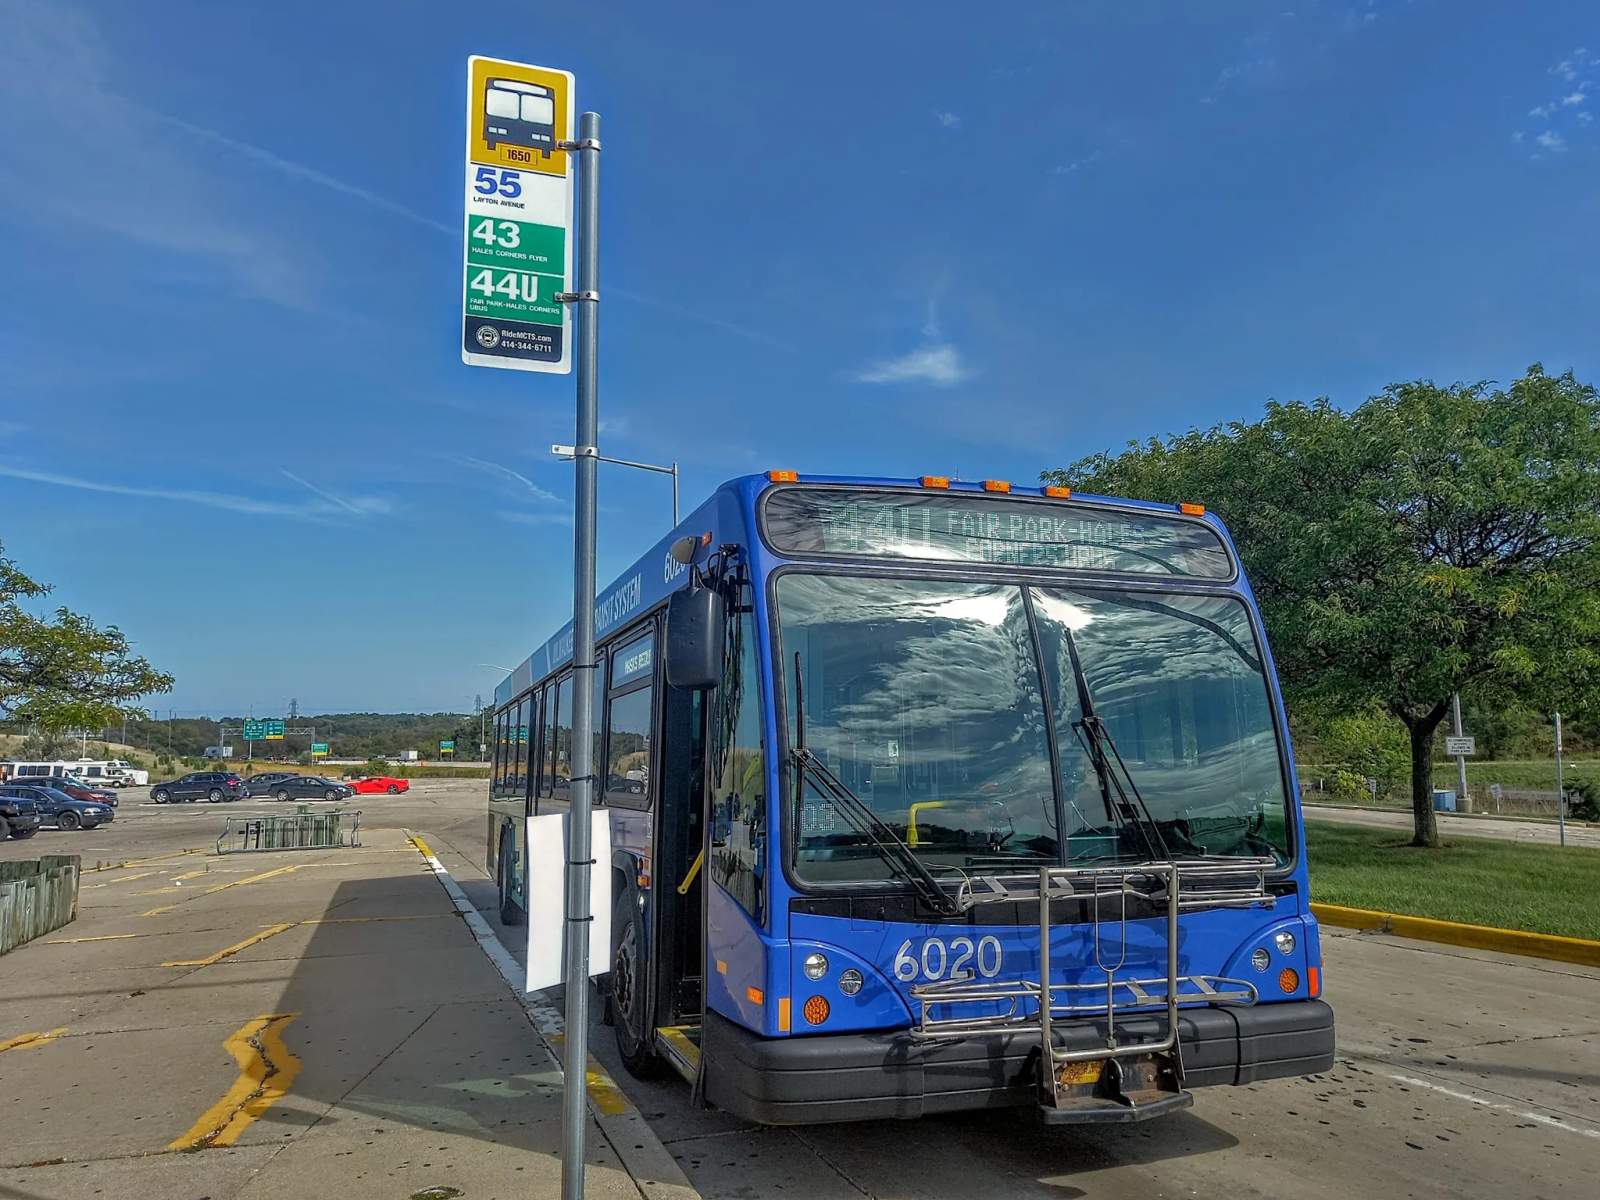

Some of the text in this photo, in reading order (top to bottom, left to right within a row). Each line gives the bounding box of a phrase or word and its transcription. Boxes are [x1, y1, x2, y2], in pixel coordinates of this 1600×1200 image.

[507, 149, 531, 163] 1650
[474, 167, 522, 198] 55
[473, 196, 525, 209] LAYTON AVENUE
[472, 219, 521, 249] 43
[471, 246, 548, 263] HALES CORNERS FLYER
[470, 269, 539, 303] 44U
[469, 304, 488, 312] UBUS
[470, 297, 560, 315] FAIR PARK-HALES CORNERS
[501, 329, 552, 343] RideMCTS.com
[501, 340, 552, 353] 414-344-6711
[947, 511, 1000, 539] FAIR
[894, 935, 1002, 982] 6020
